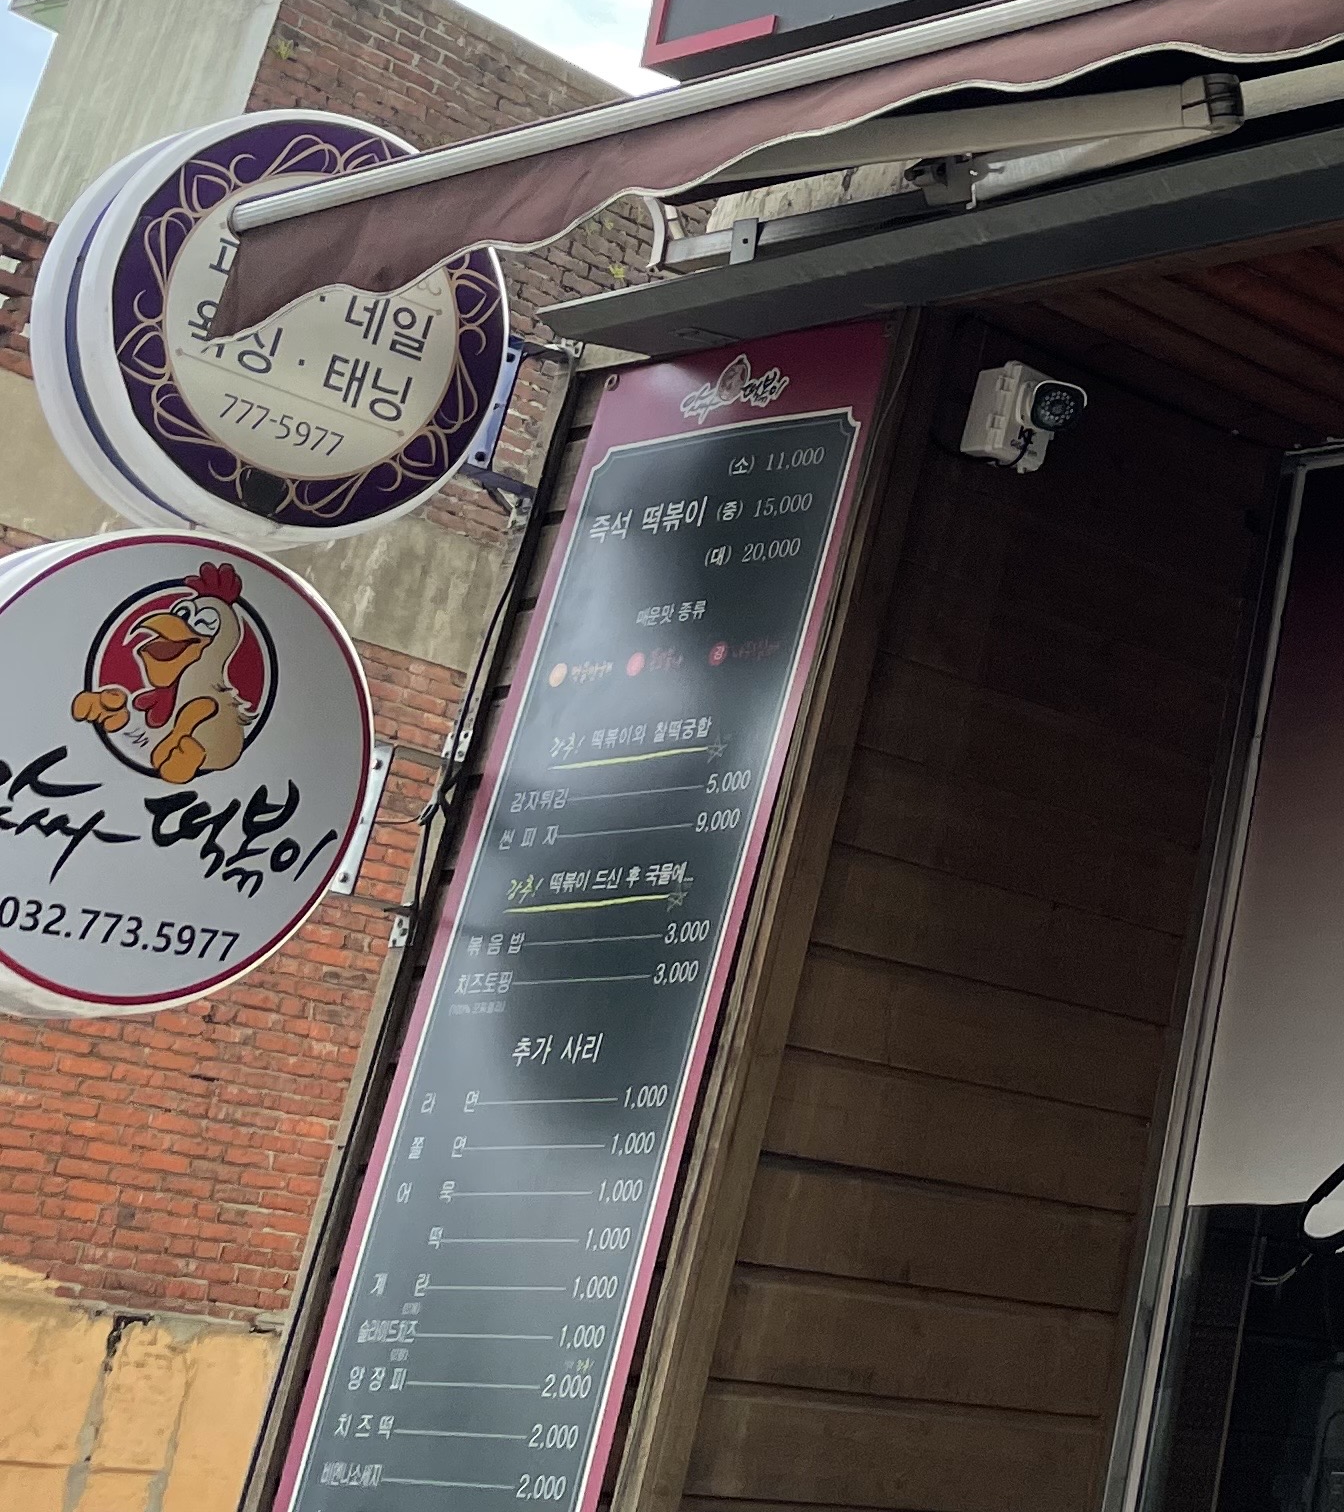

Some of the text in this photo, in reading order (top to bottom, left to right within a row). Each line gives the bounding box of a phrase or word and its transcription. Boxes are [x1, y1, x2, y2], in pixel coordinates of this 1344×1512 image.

[345, 295, 434, 361] 네일
[323, 354, 412, 421] 태닝
[219, 394, 344, 456] 777-5977
[728, 446, 825, 476] (소) 11,000
[589, 492, 813, 543] 즉석 떡볶이 (중) 15,000
[704, 538, 801, 568] (대) 20,000
[636, 599, 707, 627] 매운맛 종류
[591, 724, 647, 749] 떡볶이와
[653, 716, 712, 744] 찰떡궁합
[706, 770, 751, 795] 5,000
[510, 789, 569, 813] 감자튀김
[695, 808, 741, 834] 9,000
[144, 779, 338, 898] 떡볶이
[549, 870, 590, 894] 떡볶이
[592, 867, 623, 889] 드신
[626, 866, 642, 887] 후
[0, 896, 240, 962] 032.773.5977
[664, 919, 711, 946] 3,000
[454, 970, 513, 995] 치즈토핑
[653, 960, 699, 986] 3,000
[511, 1032, 604, 1067] 추가 사리
[623, 1084, 668, 1109] 1,000
[610, 1131, 656, 1156] 1,000
[597, 1178, 643, 1204] 1,000
[428, 1226, 444, 1250] 떡
[585, 1226, 631, 1252] 1,000
[572, 1275, 618, 1300] 1,000
[559, 1324, 606, 1349] 1,000
[541, 1373, 592, 1399] 2,000
[528, 1423, 579, 1450] 2,000
[516, 1473, 567, 1502] 2,000
